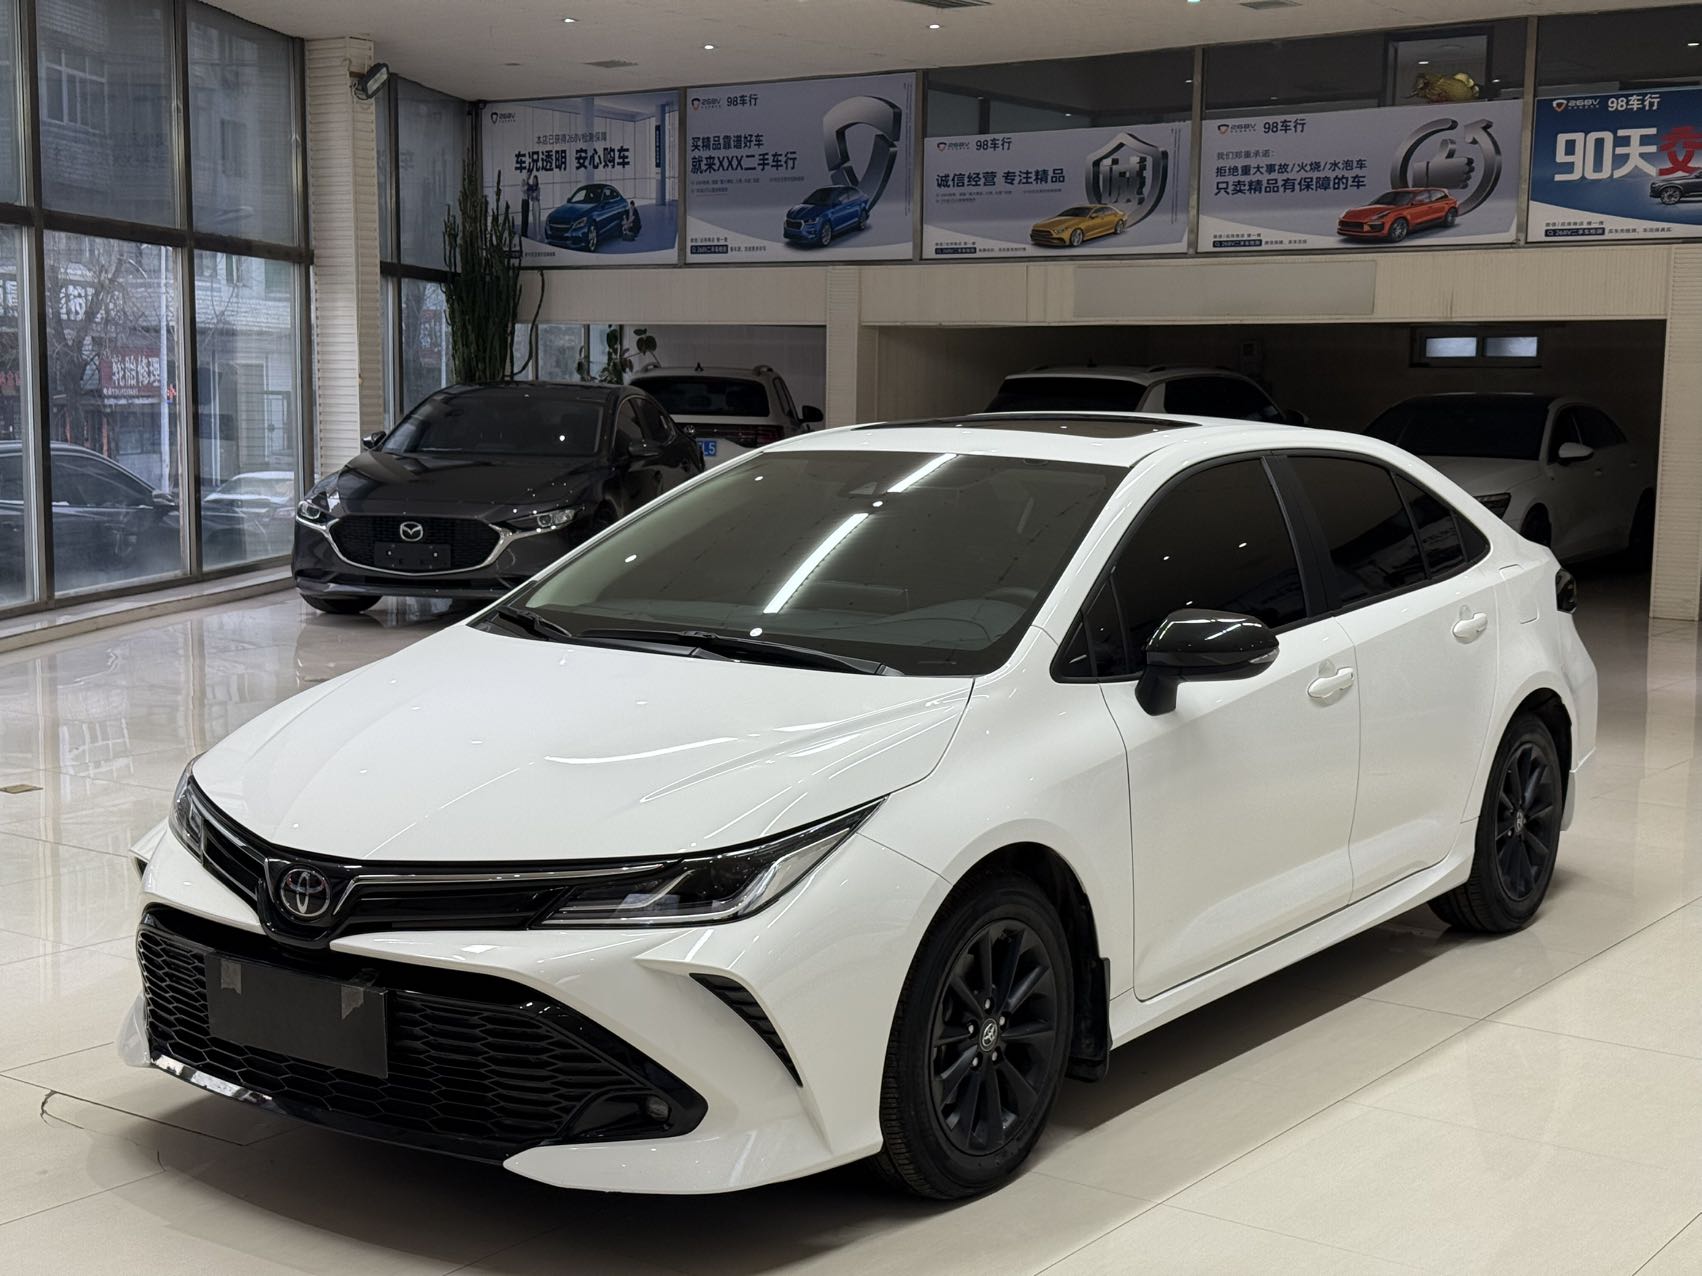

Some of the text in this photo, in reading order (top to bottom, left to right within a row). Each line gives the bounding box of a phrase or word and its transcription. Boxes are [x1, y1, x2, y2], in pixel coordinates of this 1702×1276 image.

[726, 93, 759, 108] 98车行
[1568, 98, 1599, 106] 268V
[1608, 93, 1661, 111] 98车行
[1263, 118, 1307, 134] 98车行
[690, 133, 764, 152] 买精品靠谱好车
[975, 137, 1012, 151] 98车行
[514, 149, 568, 174] 车况透明
[575, 145, 631, 171] 安心购车
[690, 151, 797, 174] 就来XXX二手车行
[1215, 159, 1367, 177] 拒绝重大事故/火烧/水泡车
[936, 168, 1066, 189] 诚信经营 专注精品
[1214, 174, 1367, 196] 只卖精品有保障的车
